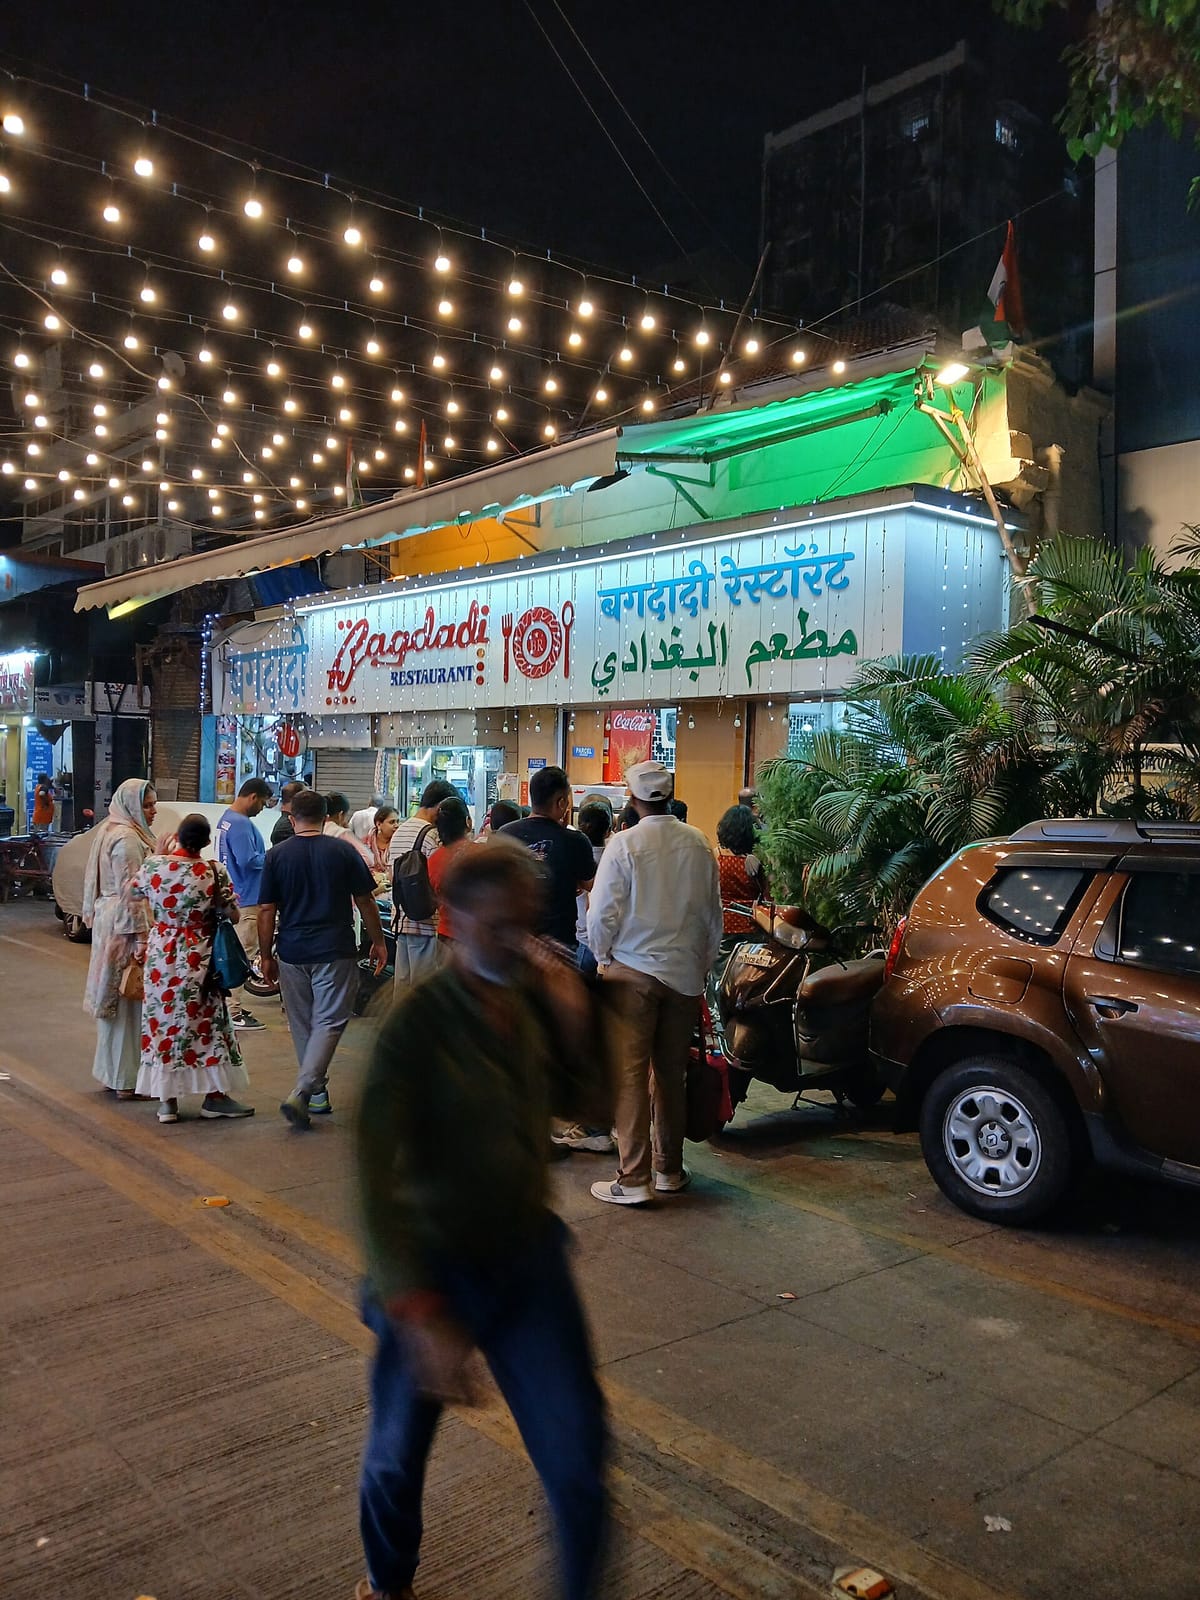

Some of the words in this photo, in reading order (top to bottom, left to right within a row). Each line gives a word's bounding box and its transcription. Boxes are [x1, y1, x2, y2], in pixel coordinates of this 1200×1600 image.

[597, 560, 715, 622] बगदादी
[227, 624, 310, 709] बगदादी
[326, 599, 490, 692] Bagdadi
[390, 665, 475, 687] RESTAURANT
[591, 620, 728, 695] البغدادي
[744, 607, 858, 687] مطعم
[575, 746, 592, 755] PARCEL
